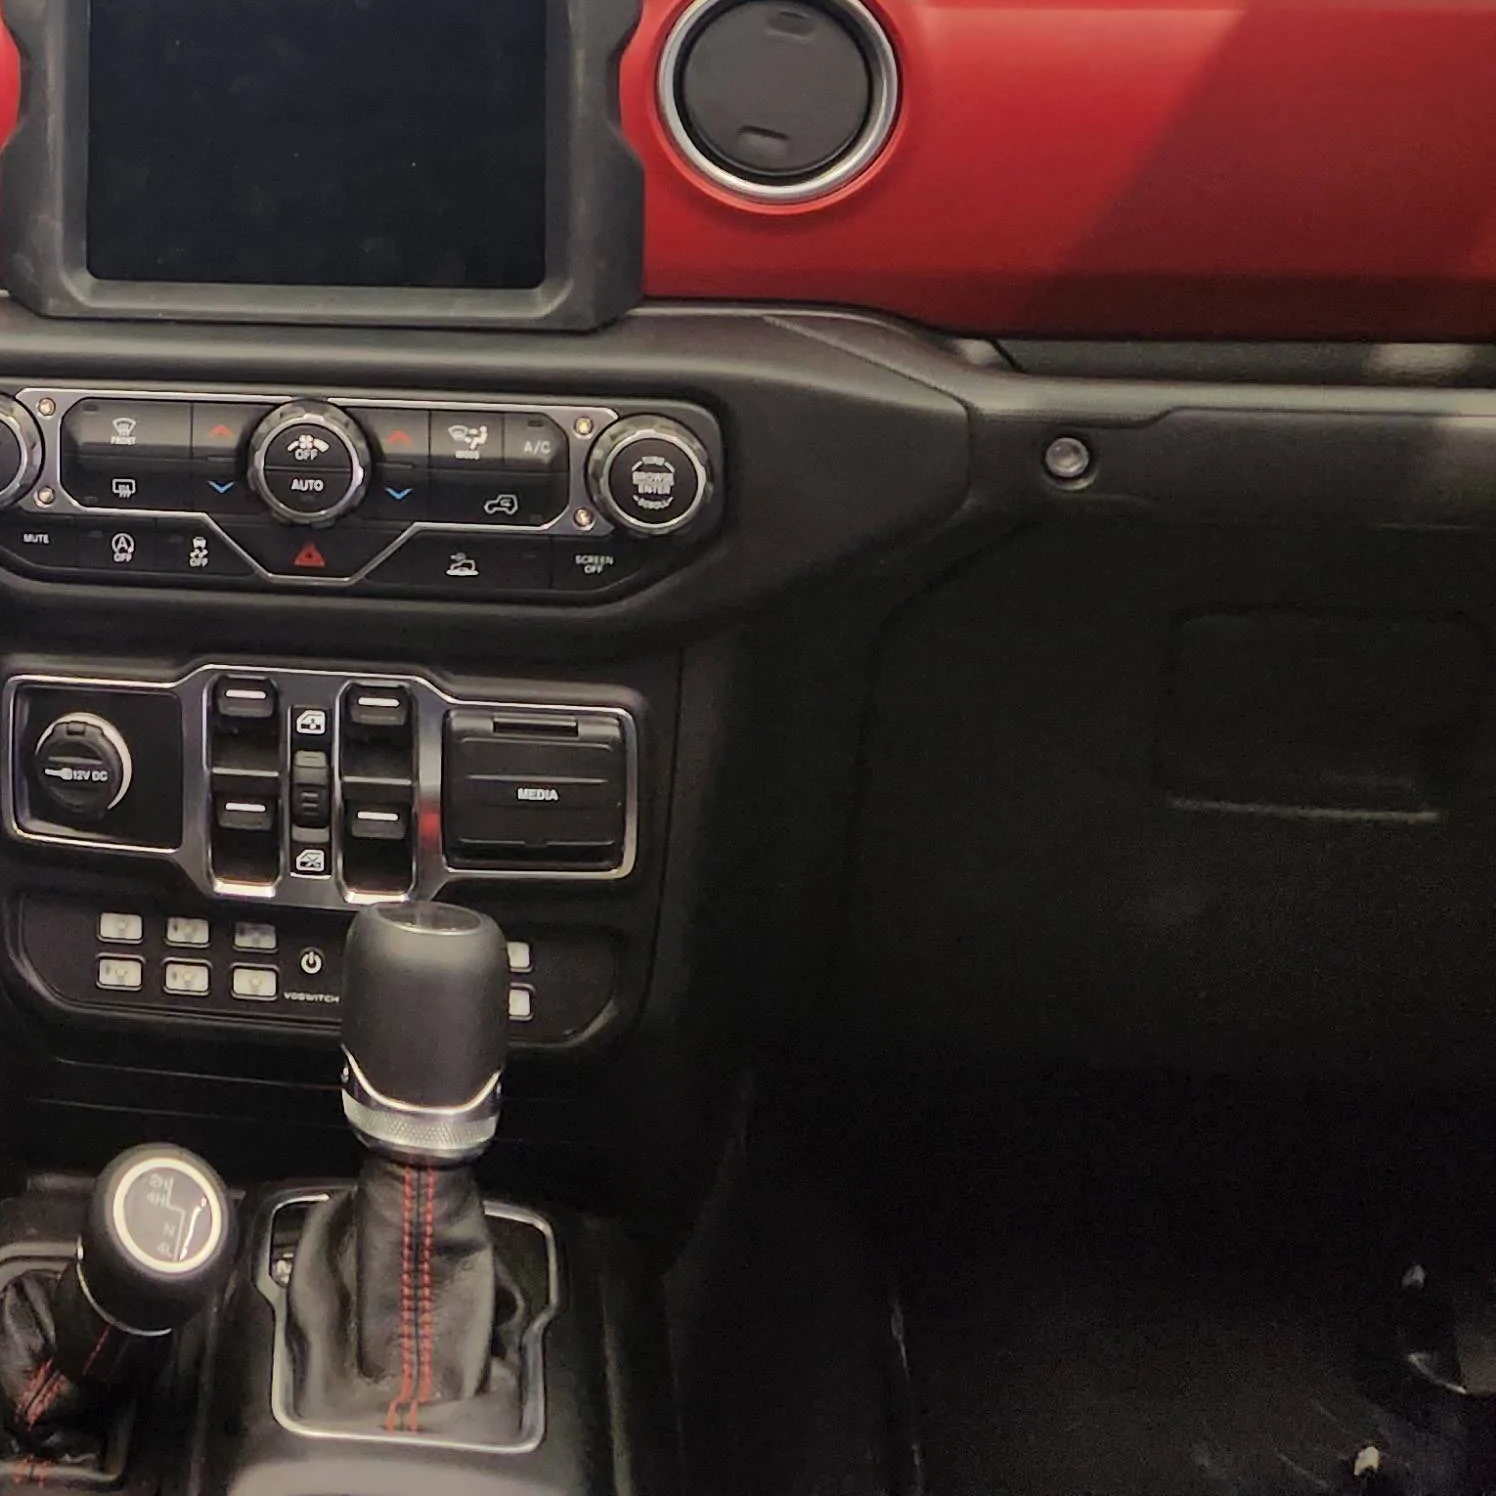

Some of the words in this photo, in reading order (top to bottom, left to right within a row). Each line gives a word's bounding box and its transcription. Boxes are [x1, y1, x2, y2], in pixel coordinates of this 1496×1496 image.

[524, 439, 551, 455] A/C
[294, 449, 317, 460] OFF
[291, 478, 324, 491] AUTO
[23, 533, 49, 544] MUTE
[113, 552, 132, 562] OFF
[190, 558, 208, 567] OFF
[575, 554, 614, 565] SCREEN
[584, 564, 603, 574] OFF
[73, 769, 91, 781] 12V
[92, 770, 108, 781] DC
[517, 787, 559, 801] MEDIA
